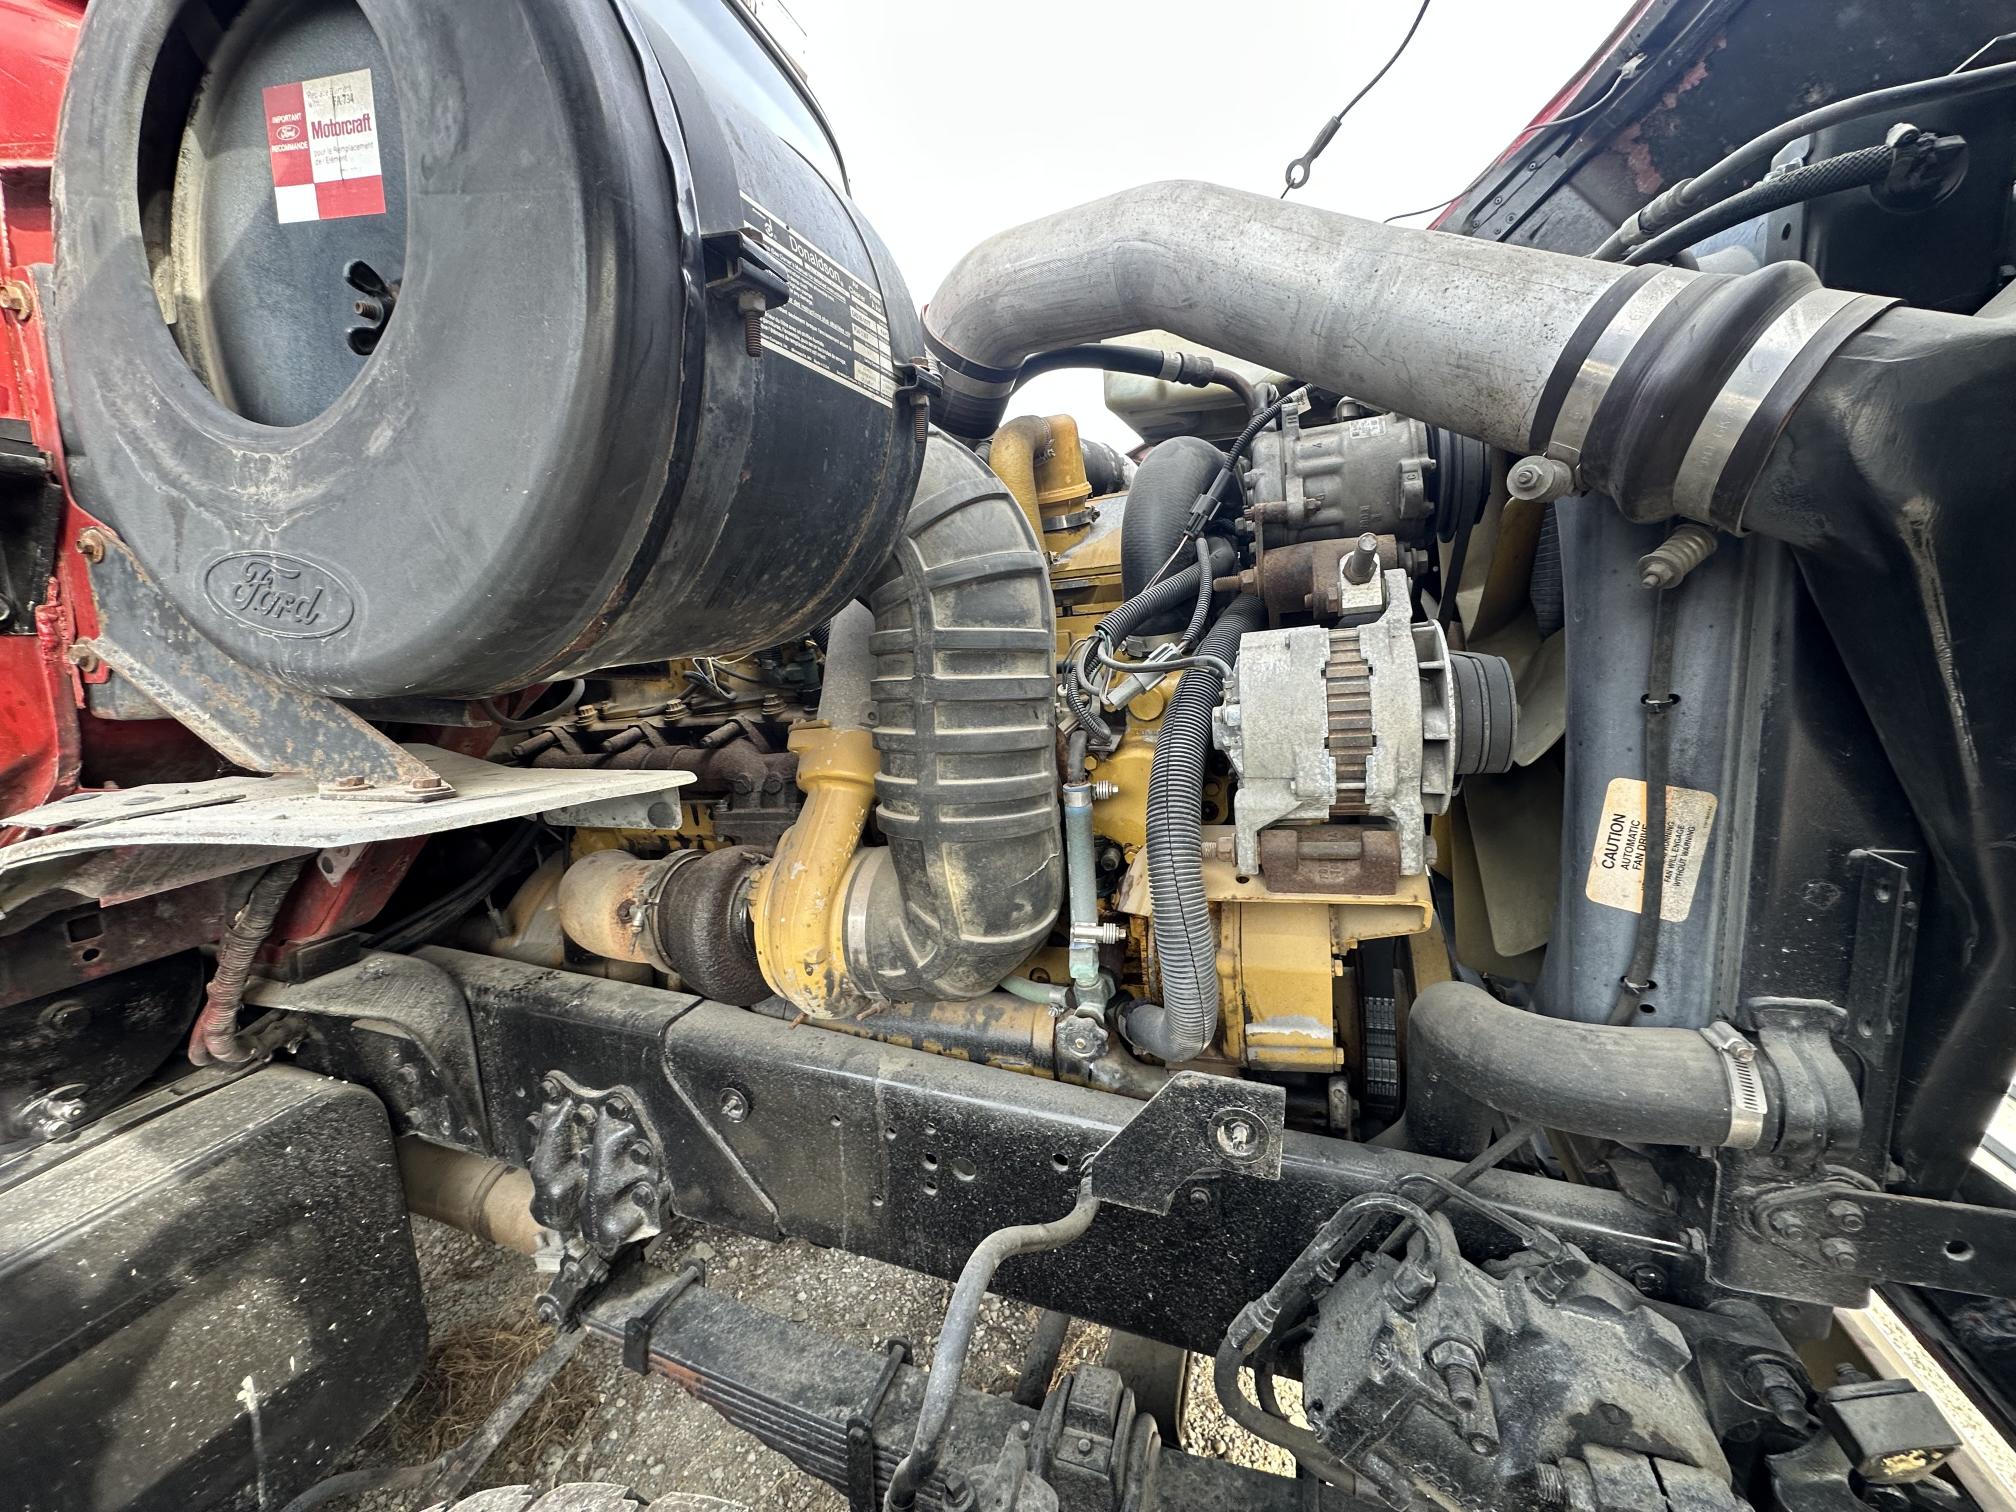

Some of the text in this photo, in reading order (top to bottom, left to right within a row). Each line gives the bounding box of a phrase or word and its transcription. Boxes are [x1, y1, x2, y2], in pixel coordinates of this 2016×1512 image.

[272, 113, 302, 124] IMPORTANT
[312, 113, 372, 140] Motorcraft
[788, 235, 841, 284] Donaldson
[232, 558, 324, 626] Ford
[1602, 813, 1627, 869] CAUTION
[1620, 819, 1640, 871] AUTOMATIC
[1632, 853, 1645, 870] FAN
[1664, 824, 1685, 882] FAN WILL ENGAGE
[1674, 826, 1695, 887] WITHOUT WARNING
